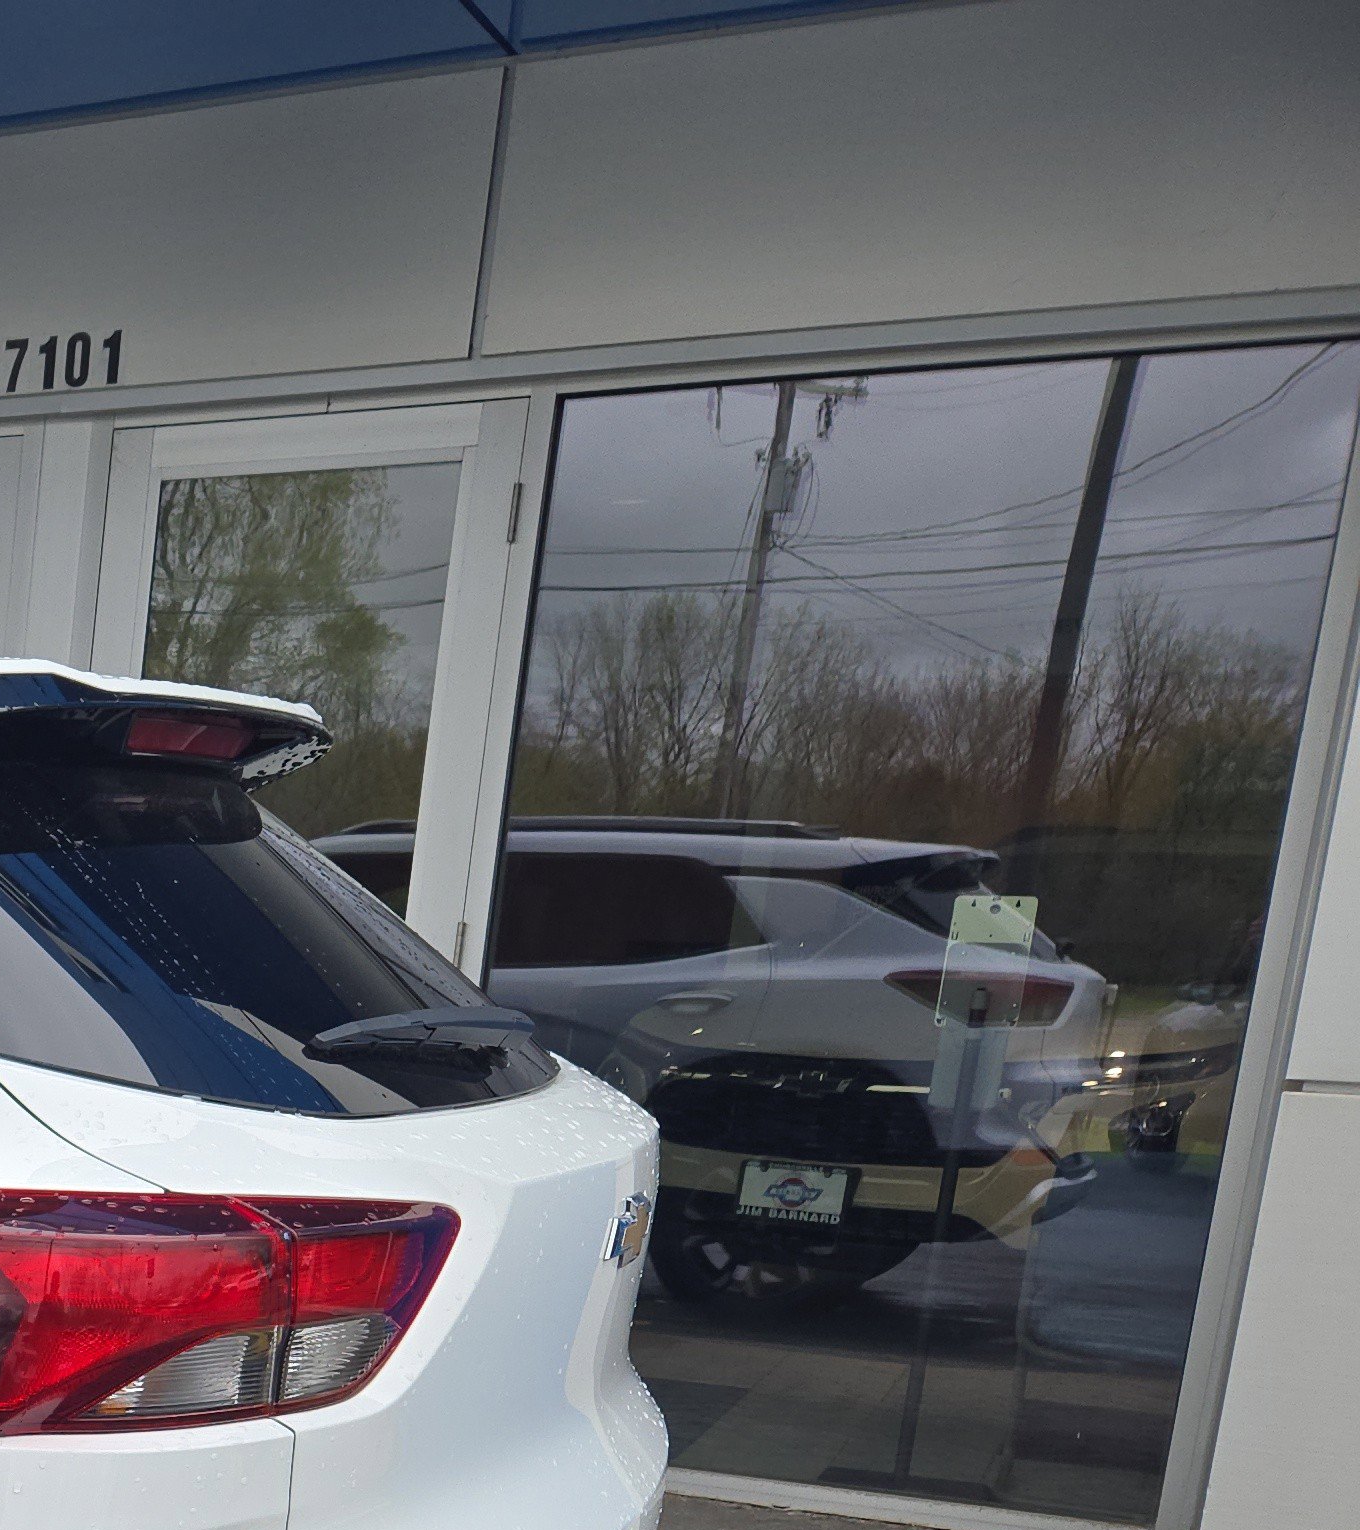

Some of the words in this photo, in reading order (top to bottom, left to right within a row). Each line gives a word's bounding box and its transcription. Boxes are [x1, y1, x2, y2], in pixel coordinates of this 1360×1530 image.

[4, 329, 122, 393] 7101
[735, 1204, 763, 1217] JIM
[768, 1207, 840, 1224] BARNARD
